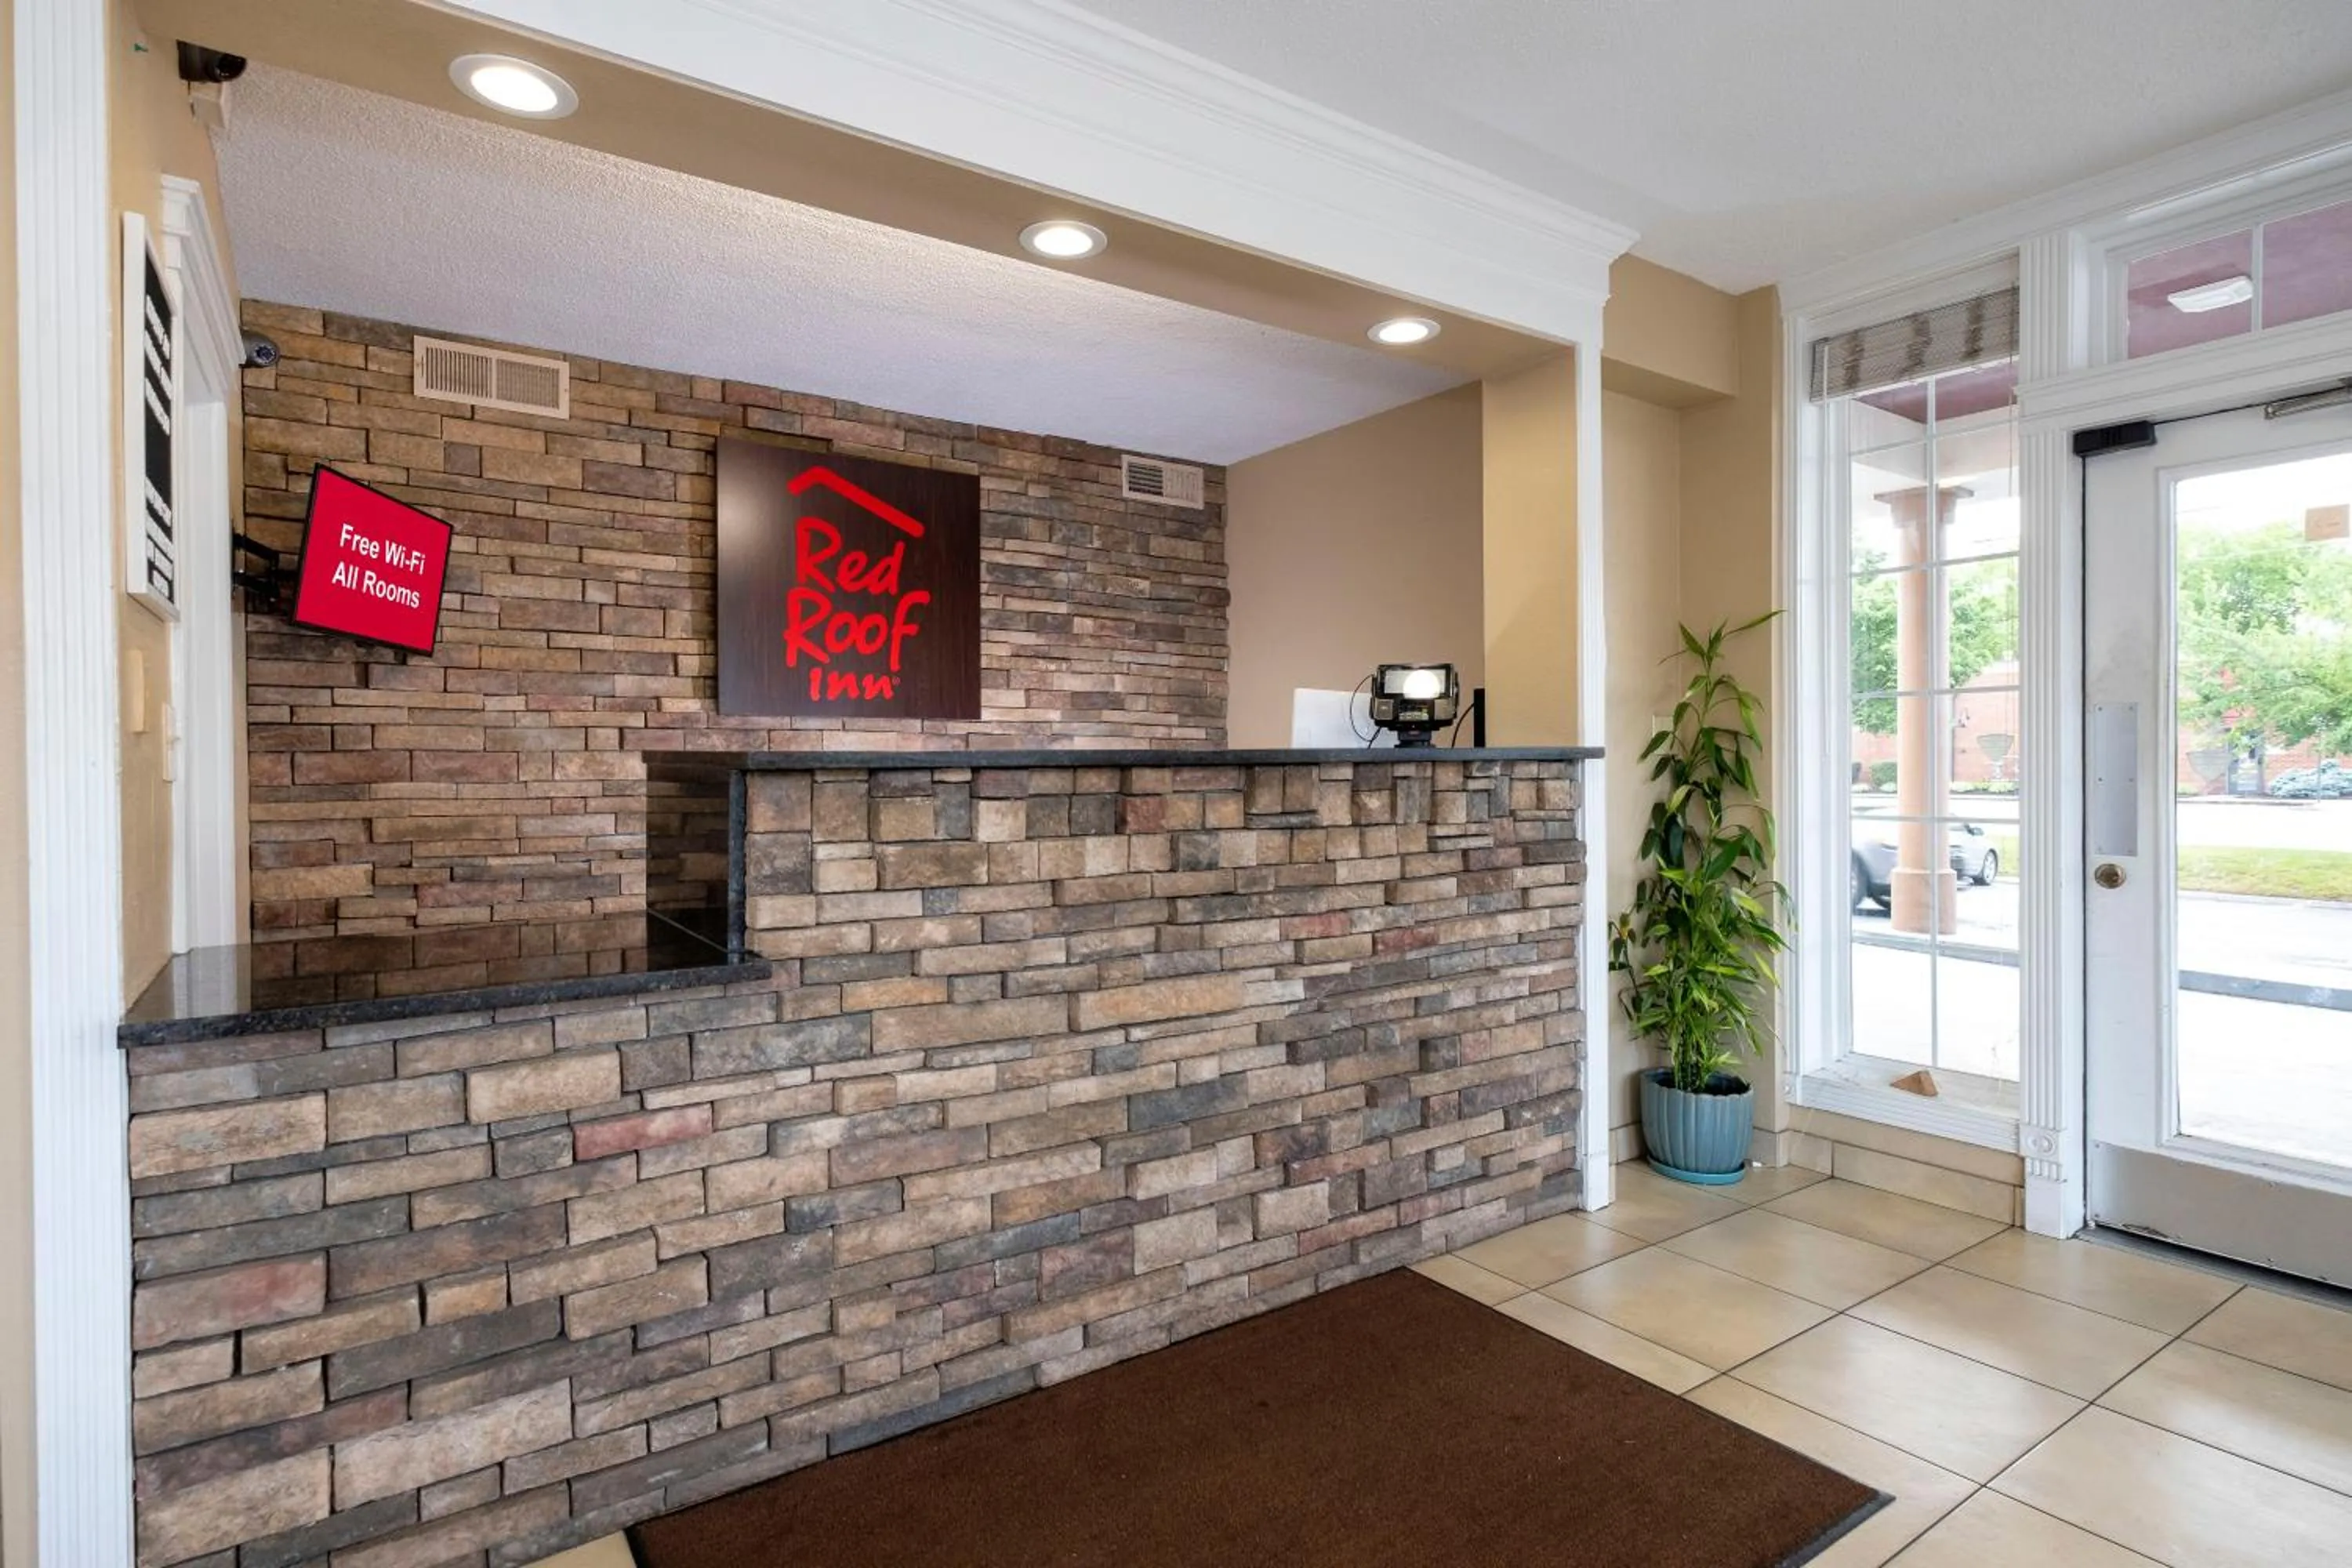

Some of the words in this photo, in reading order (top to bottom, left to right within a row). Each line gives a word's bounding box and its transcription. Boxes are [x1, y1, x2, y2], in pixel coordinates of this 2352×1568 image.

[339, 523, 380, 559] Free
[384, 539, 425, 575] Wi-Fi
[795, 516, 905, 596] Red
[332, 561, 359, 590] All
[362, 569, 420, 608] Rooms
[782, 586, 931, 673] Roof
